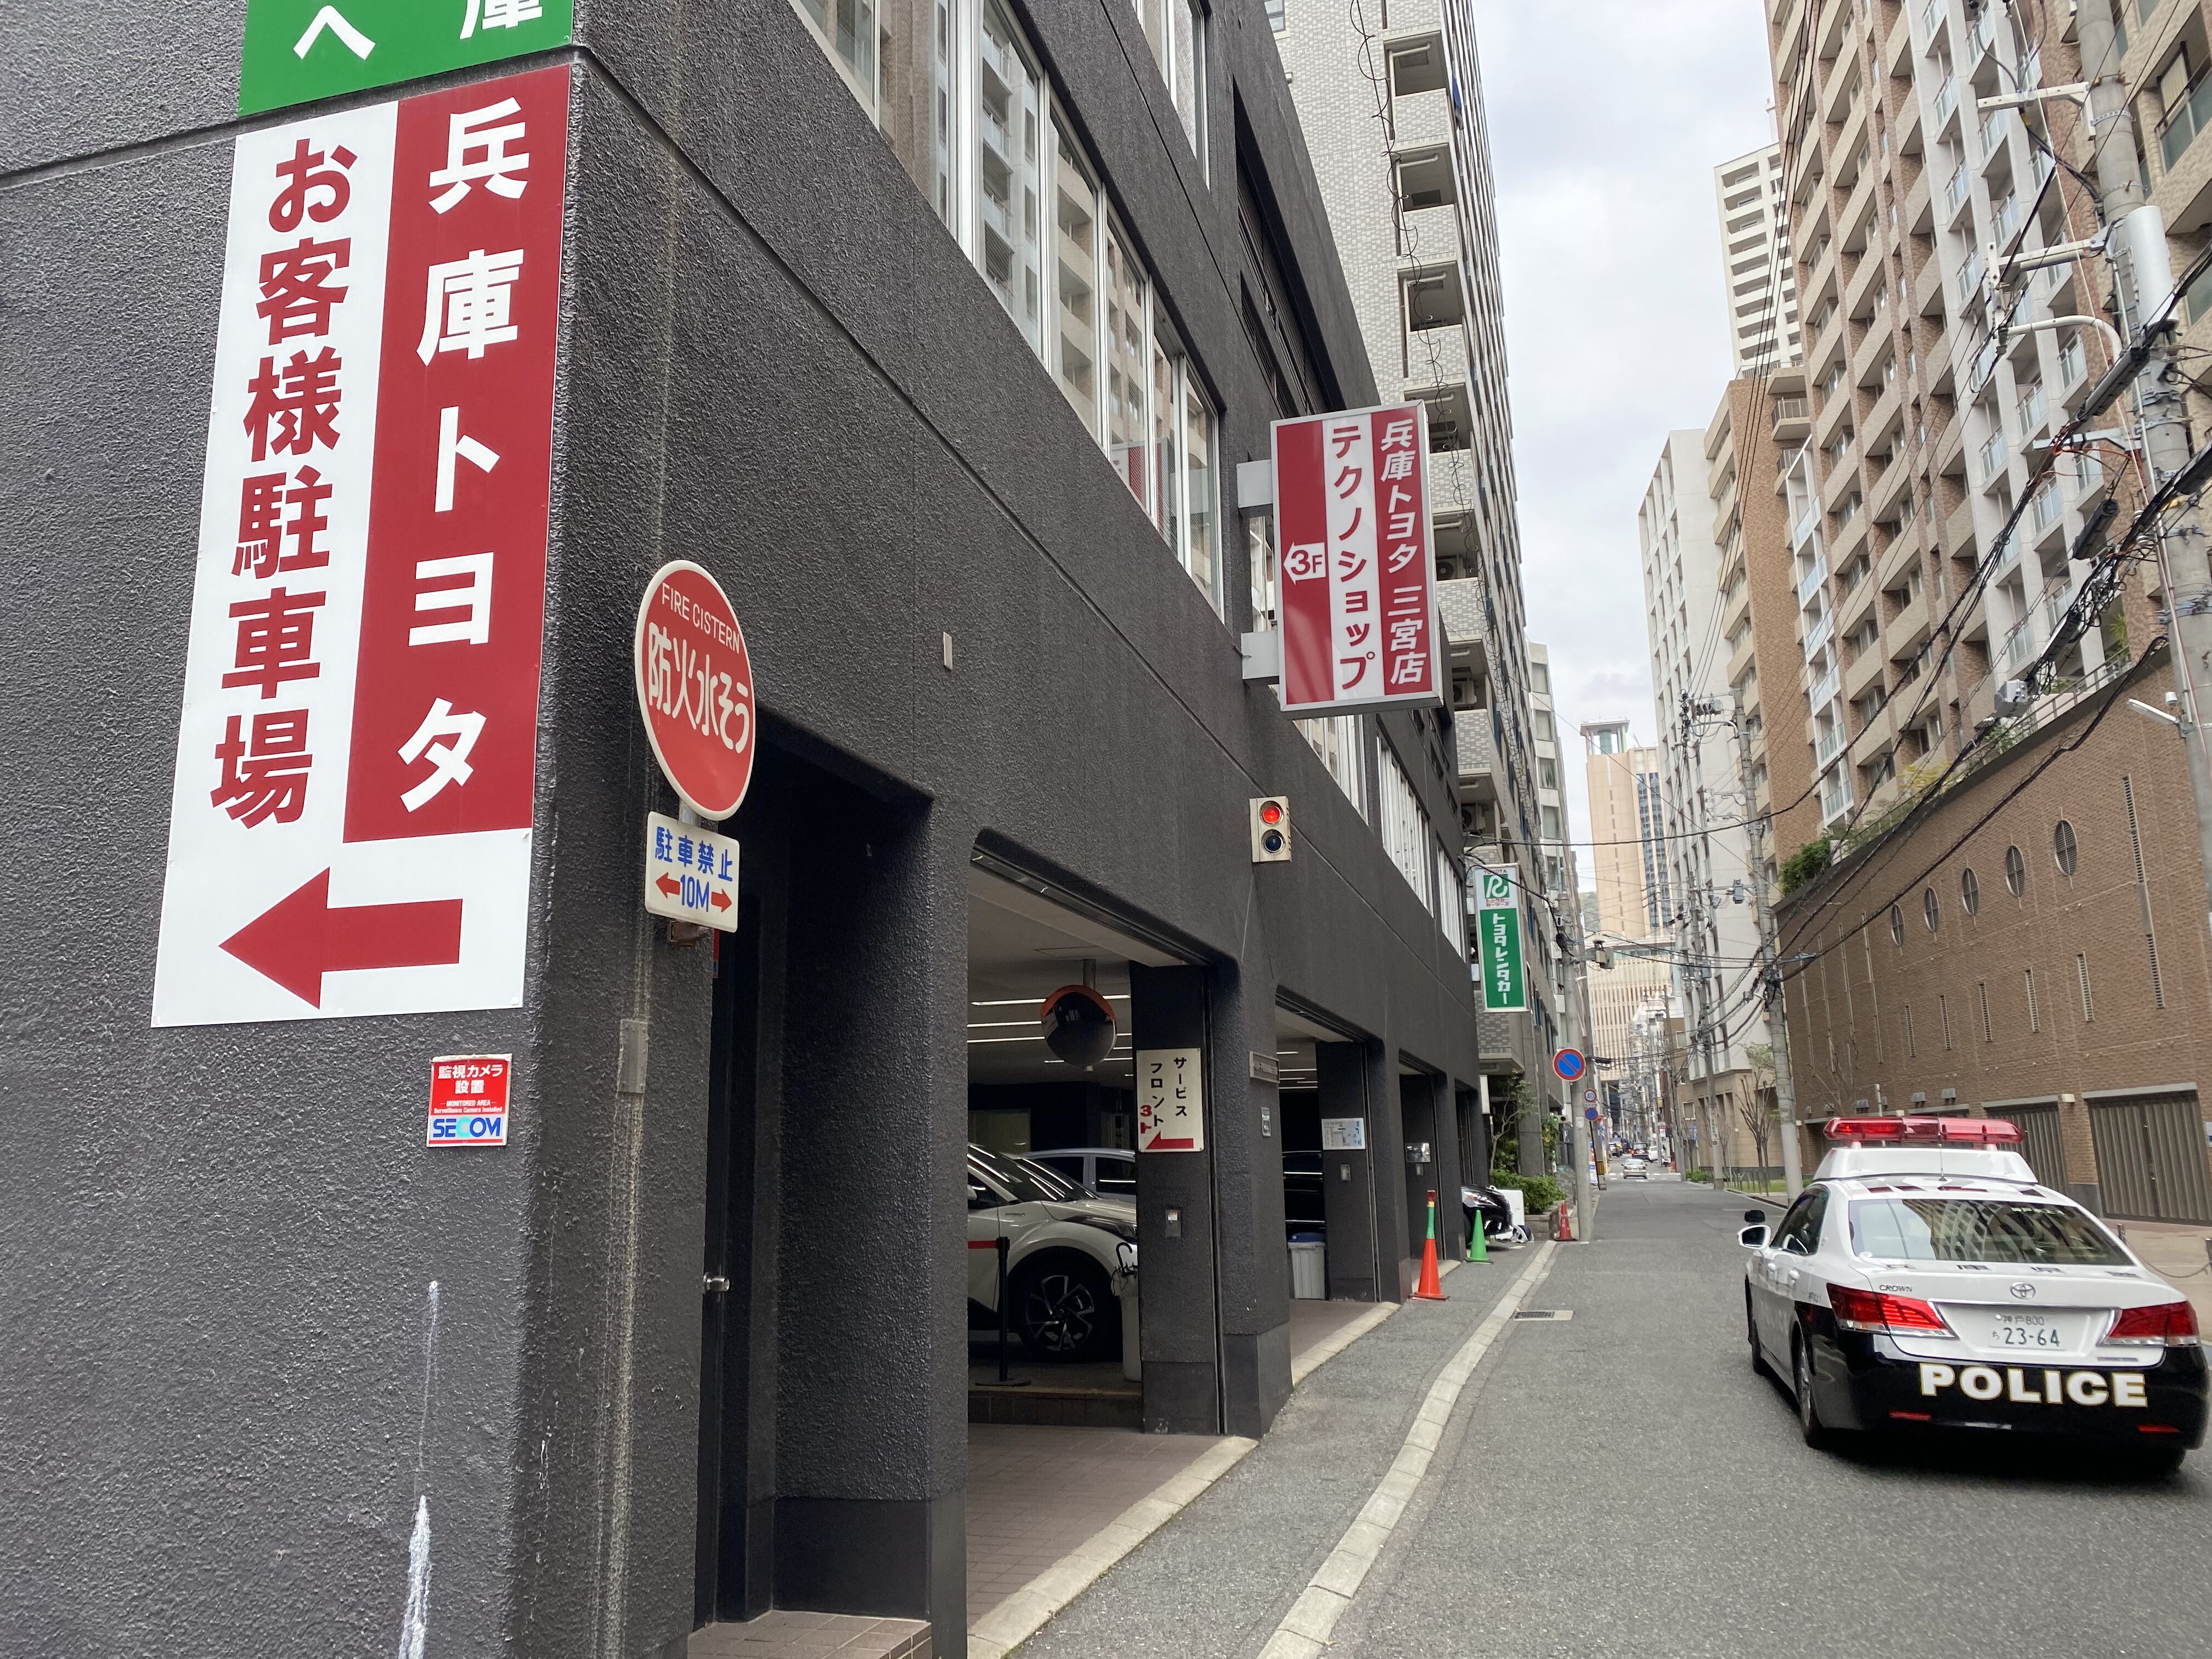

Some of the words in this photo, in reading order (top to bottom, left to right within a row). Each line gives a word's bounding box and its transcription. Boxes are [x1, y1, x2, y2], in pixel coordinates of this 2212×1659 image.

[210, 138, 358, 829] お客様駐車場
[397, 97, 529, 813] 兵庫トヨタ
[1380, 418, 1418, 574] 兵庫トヨタ
[1290, 550, 1324, 575] 3F
[1331, 425, 1375, 690] テクノショップ
[662, 582, 690, 620] FIRE
[692, 601, 740, 654] CISTERN
[1387, 585, 1427, 685] 三宮店
[648, 622, 749, 754] 防火水そう
[655, 826, 733, 882] 駐車禁止
[680, 873, 710, 913] 10M
[1493, 913, 1511, 1005] トヨタレンタカー
[437, 1064, 504, 1079] 監視カメラ
[455, 1080, 484, 1094] 設置
[1150, 1063, 1164, 1127] フロント
[1173, 1057, 1187, 1117] サービス
[432, 1116, 501, 1138] SECOM
[1879, 1284, 1913, 1293] CROWN
[2003, 1327, 2060, 1347] 23-64
[1919, 1363, 2148, 1408] POLICE
